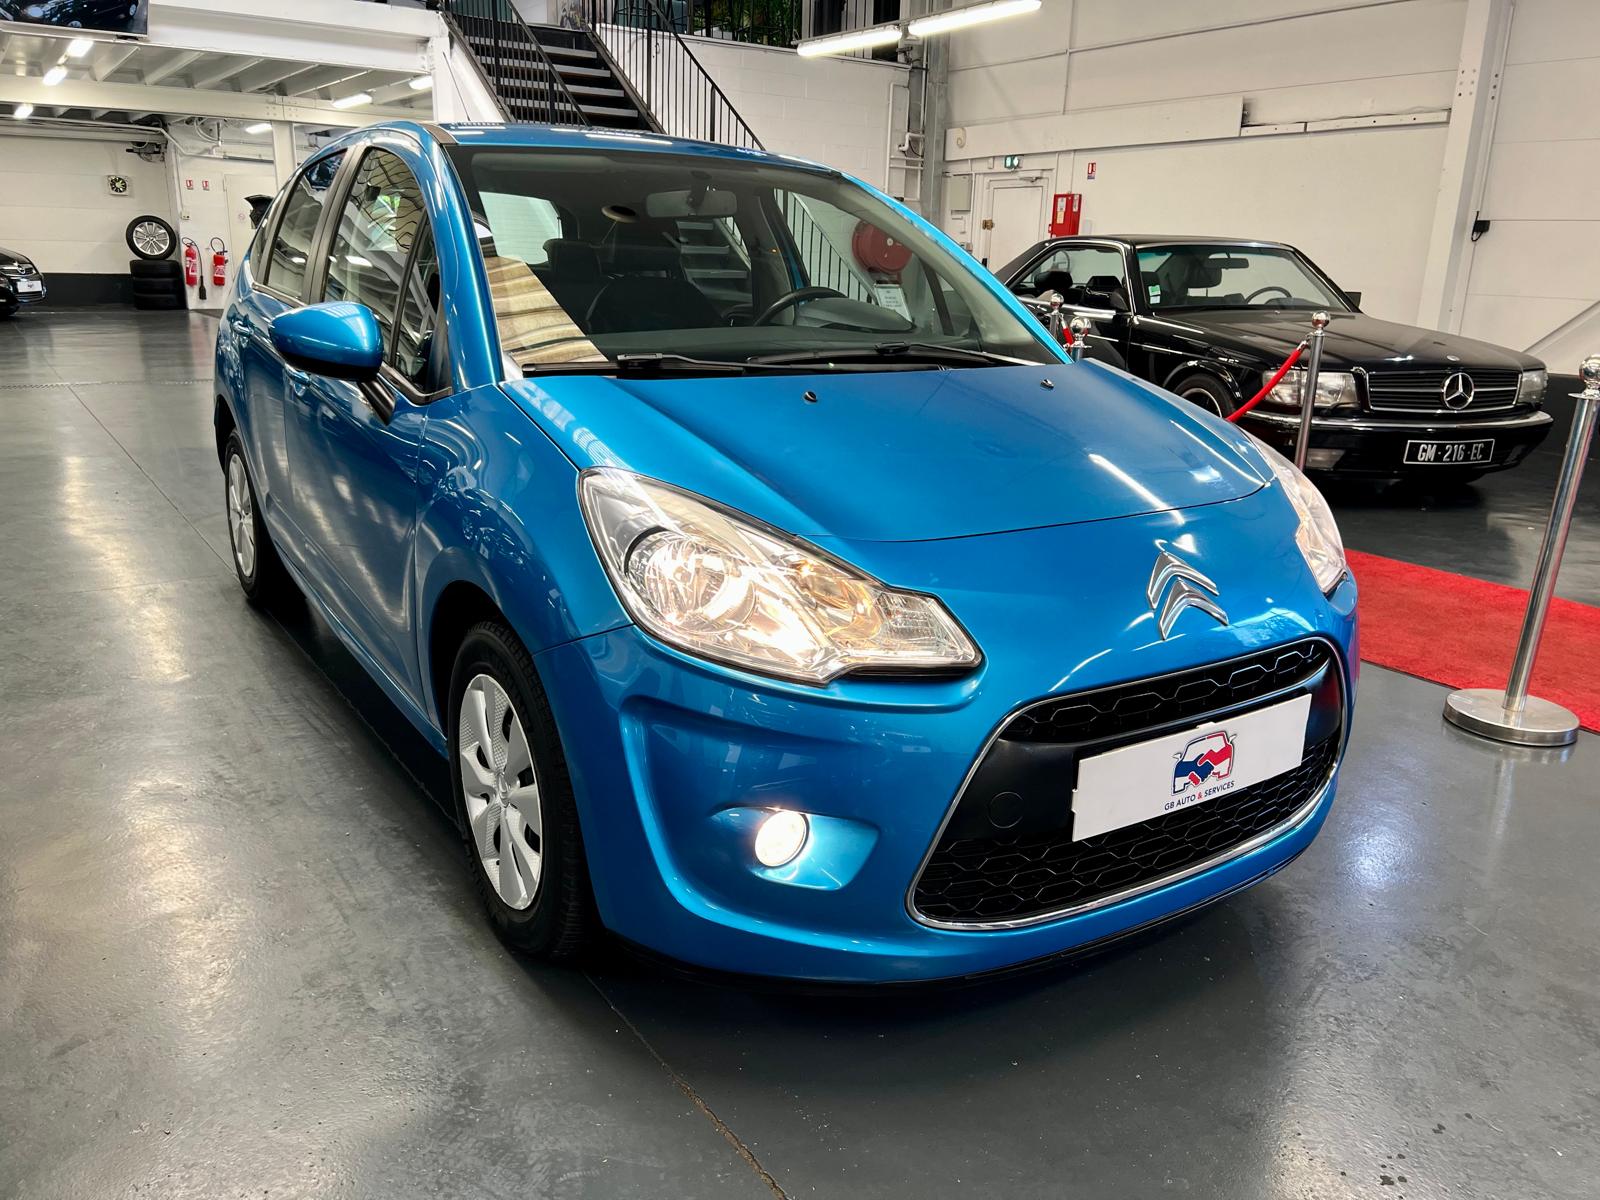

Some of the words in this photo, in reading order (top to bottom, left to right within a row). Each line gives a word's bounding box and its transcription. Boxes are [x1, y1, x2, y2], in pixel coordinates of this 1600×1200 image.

[1164, 801, 1175, 811] GB
[1176, 795, 1196, 808] AUTO
[1197, 791, 1203, 800] &
[1204, 780, 1235, 797] SERVICES
